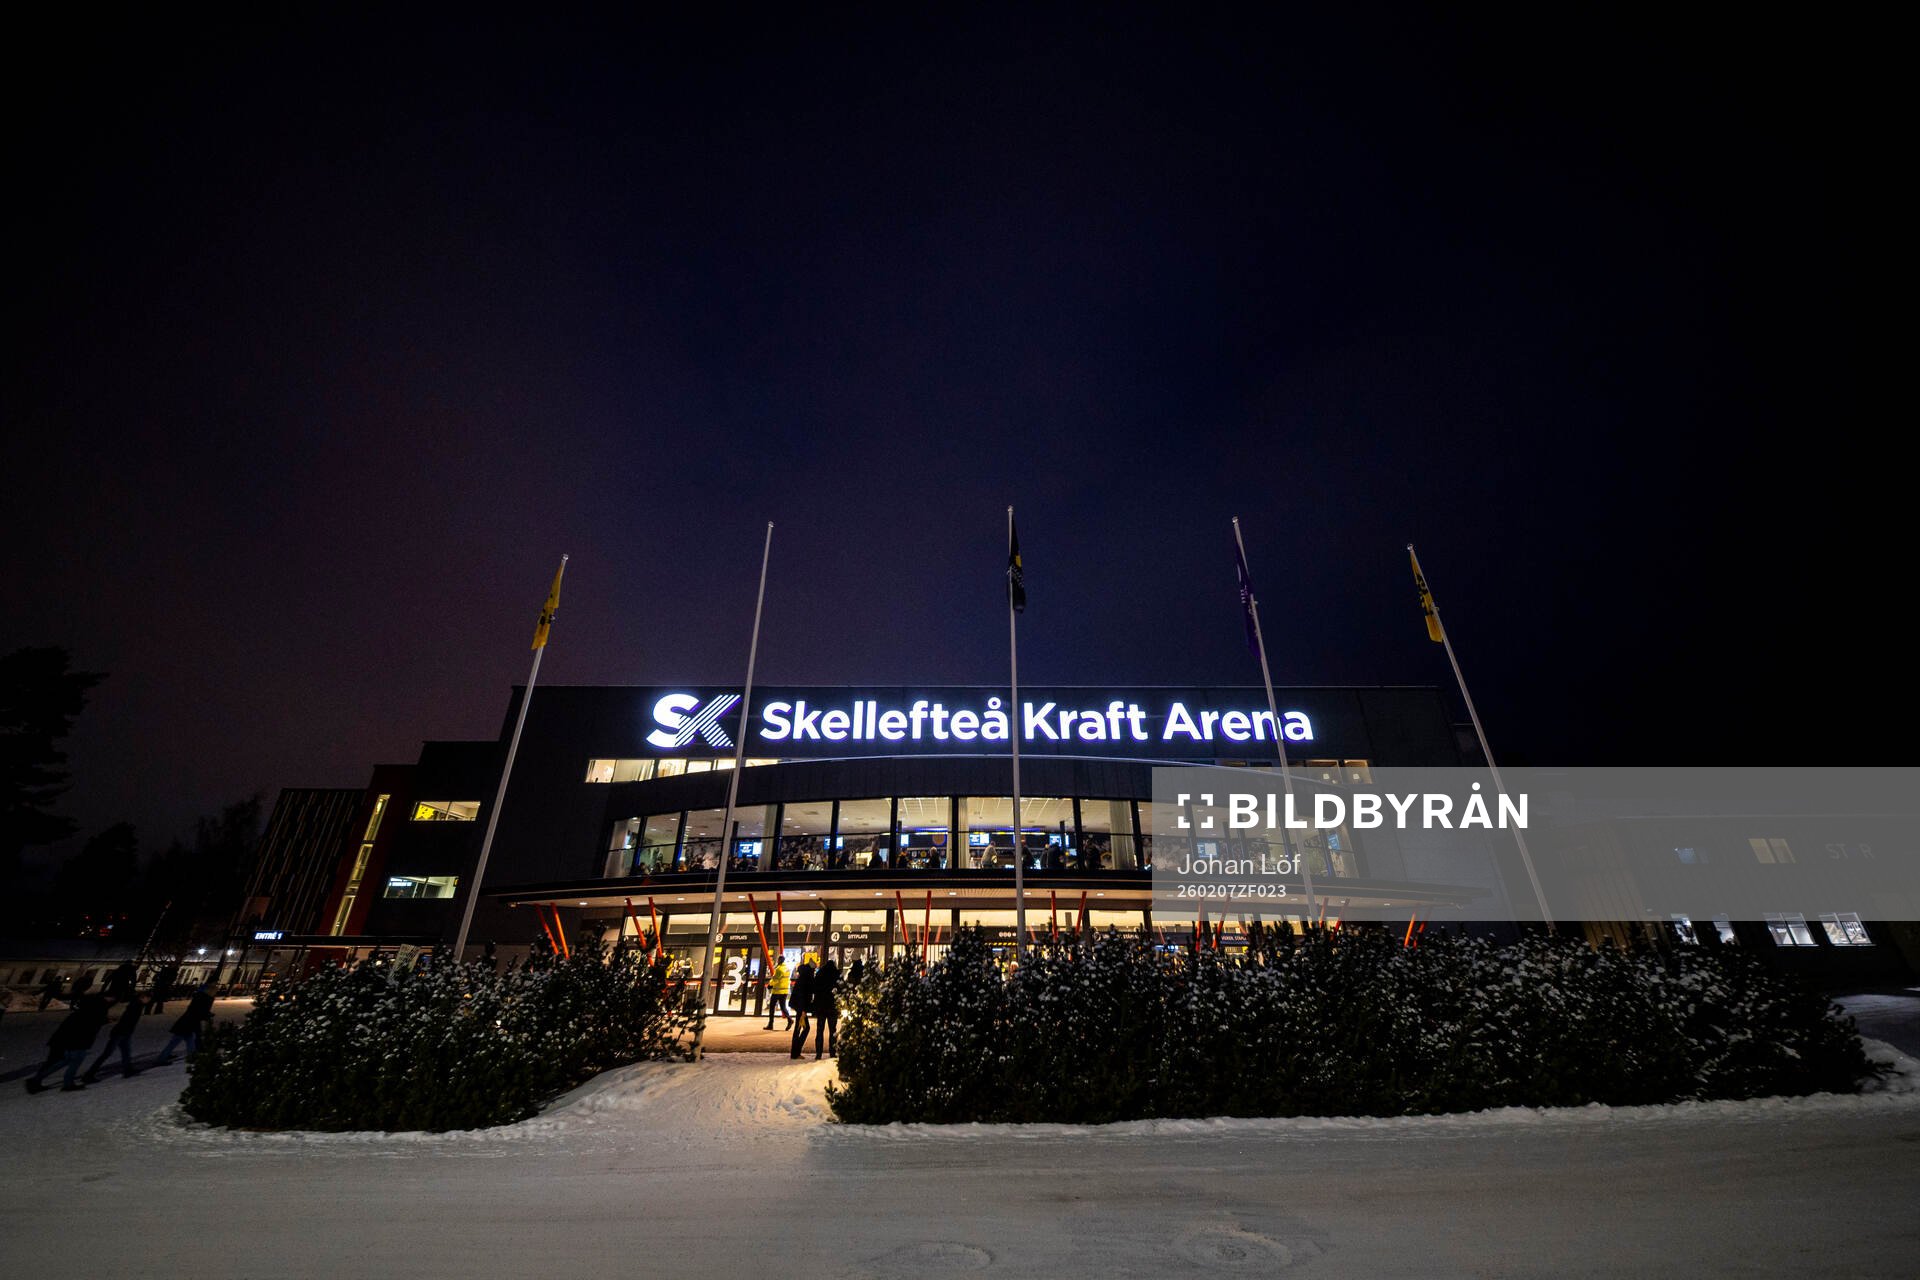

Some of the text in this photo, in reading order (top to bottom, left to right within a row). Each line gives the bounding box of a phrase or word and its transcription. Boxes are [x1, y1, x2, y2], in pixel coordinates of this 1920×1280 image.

[759, 697, 1314, 741] Skellefteå Kraft Arena
[724, 956, 743, 992] 3
